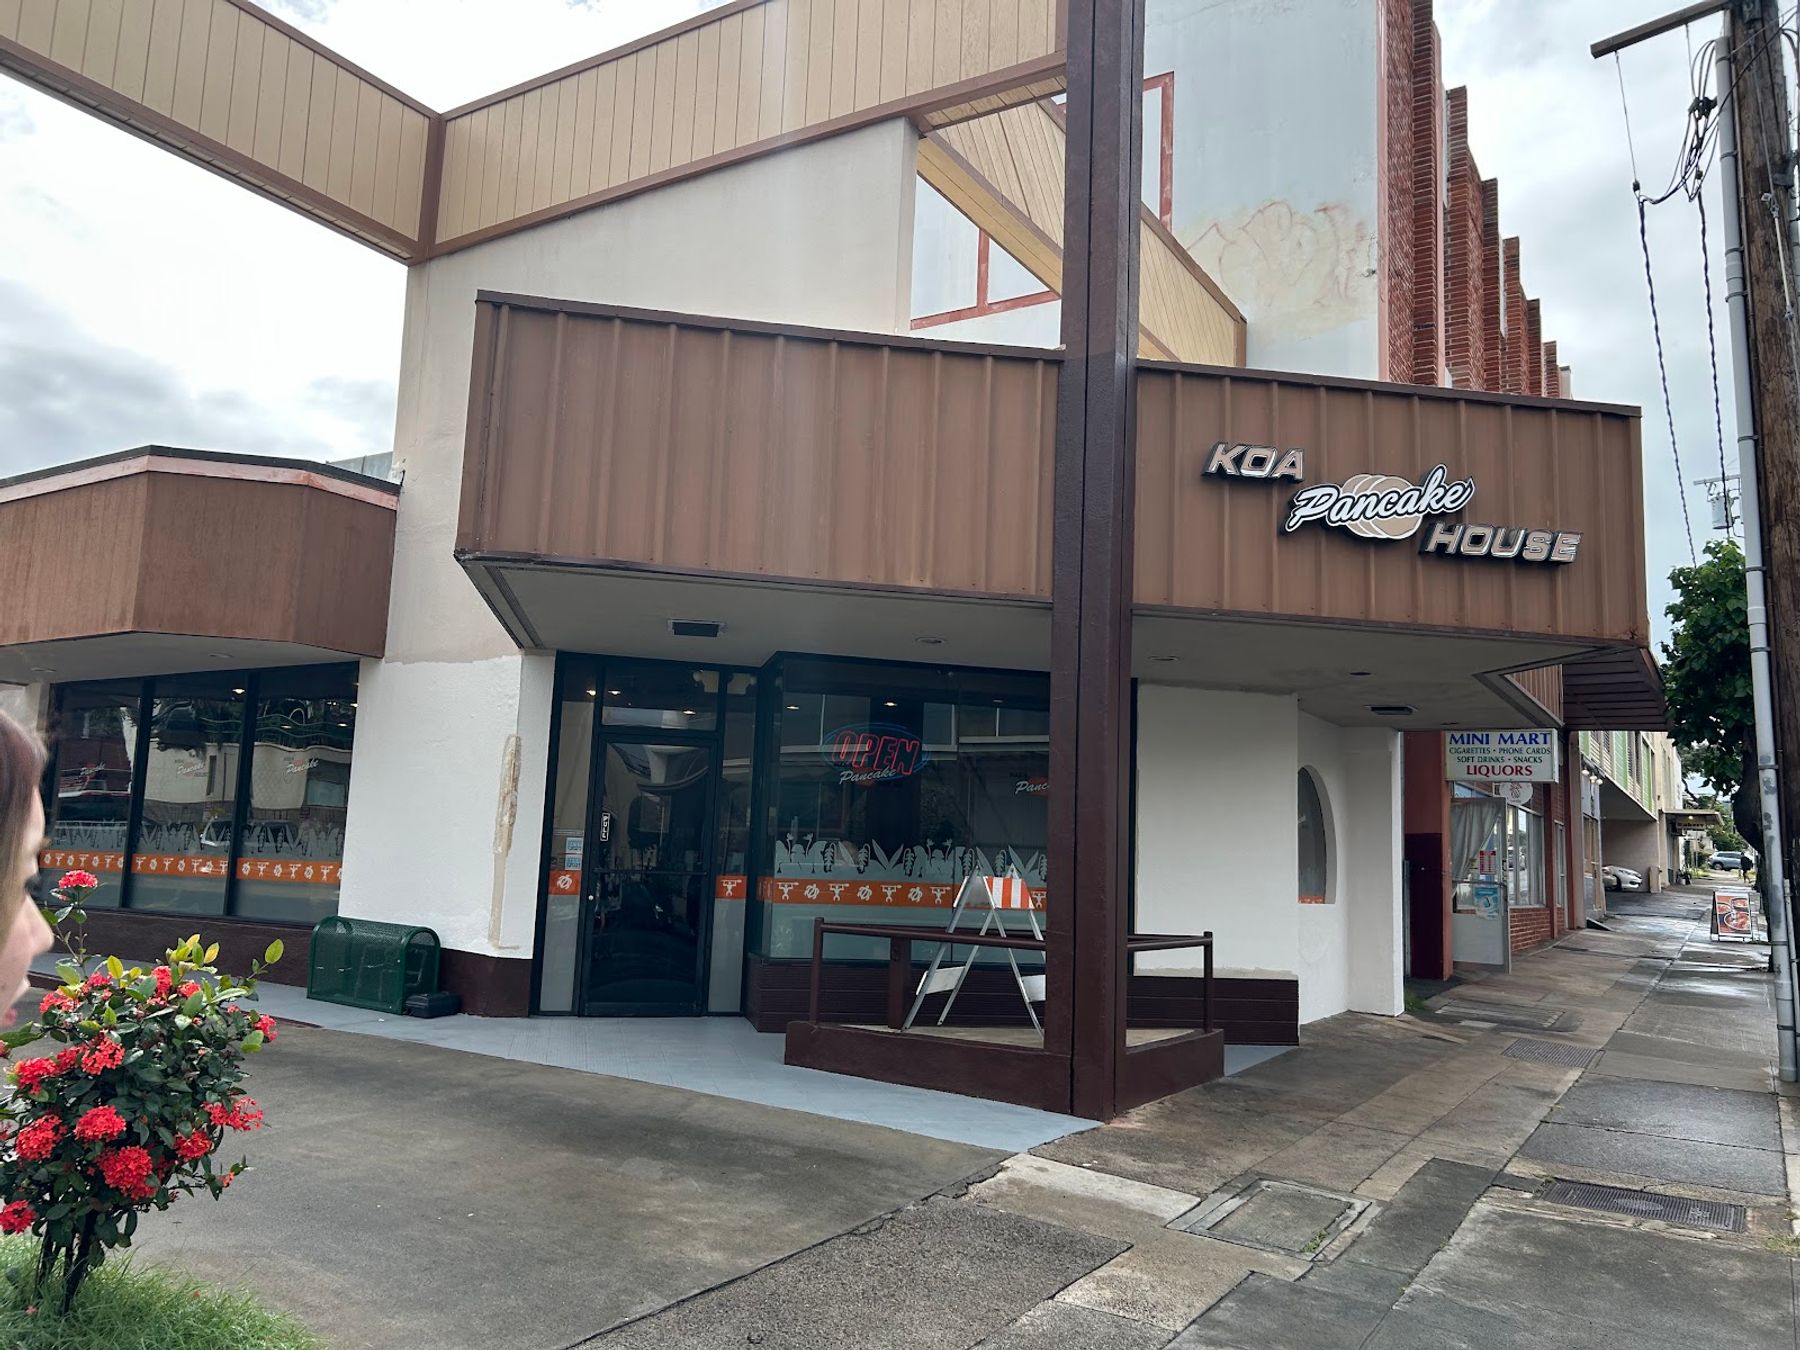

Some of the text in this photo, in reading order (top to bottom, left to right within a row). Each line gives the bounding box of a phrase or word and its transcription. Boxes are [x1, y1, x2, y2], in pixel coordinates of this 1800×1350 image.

[1204, 441, 1305, 481] KOA
[1284, 463, 1476, 532] Pancake
[1422, 522, 1583, 565] HOUSE
[1449, 732, 1551, 745] MINI MART
[831, 730, 920, 775] OPEN
[1449, 747, 1551, 755] CIGARETTES PHONE CARDS
[1513, 756, 1543, 764] SNACKS
[839, 765, 897, 785] Pancake
[1466, 764, 1533, 778] LIQUORS
[1014, 780, 1049, 795] Panc
